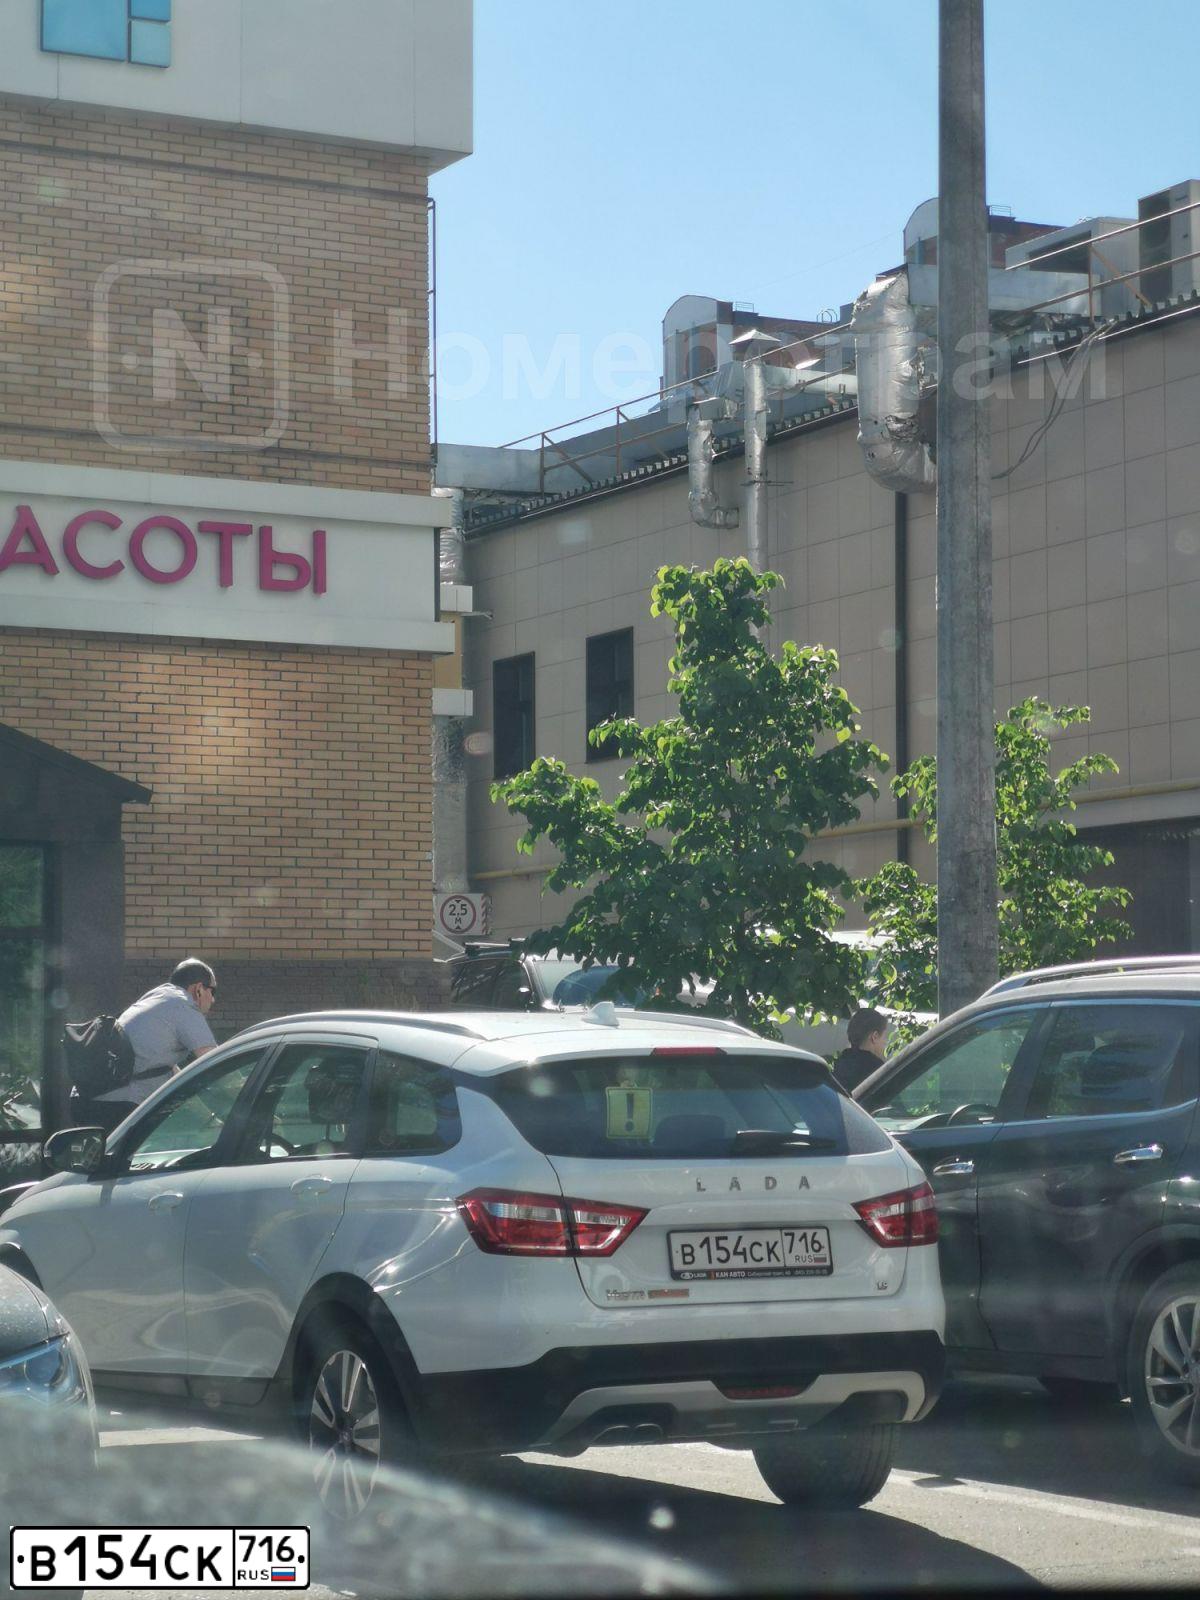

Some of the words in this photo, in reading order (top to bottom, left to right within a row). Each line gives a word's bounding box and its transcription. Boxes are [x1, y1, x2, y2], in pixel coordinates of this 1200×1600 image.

[0, 504, 327, 595] АСОТЫ
[696, 1175, 810, 1192] LADA
[784, 1231, 822, 1254] 716
[794, 1254, 813, 1264] RUS
